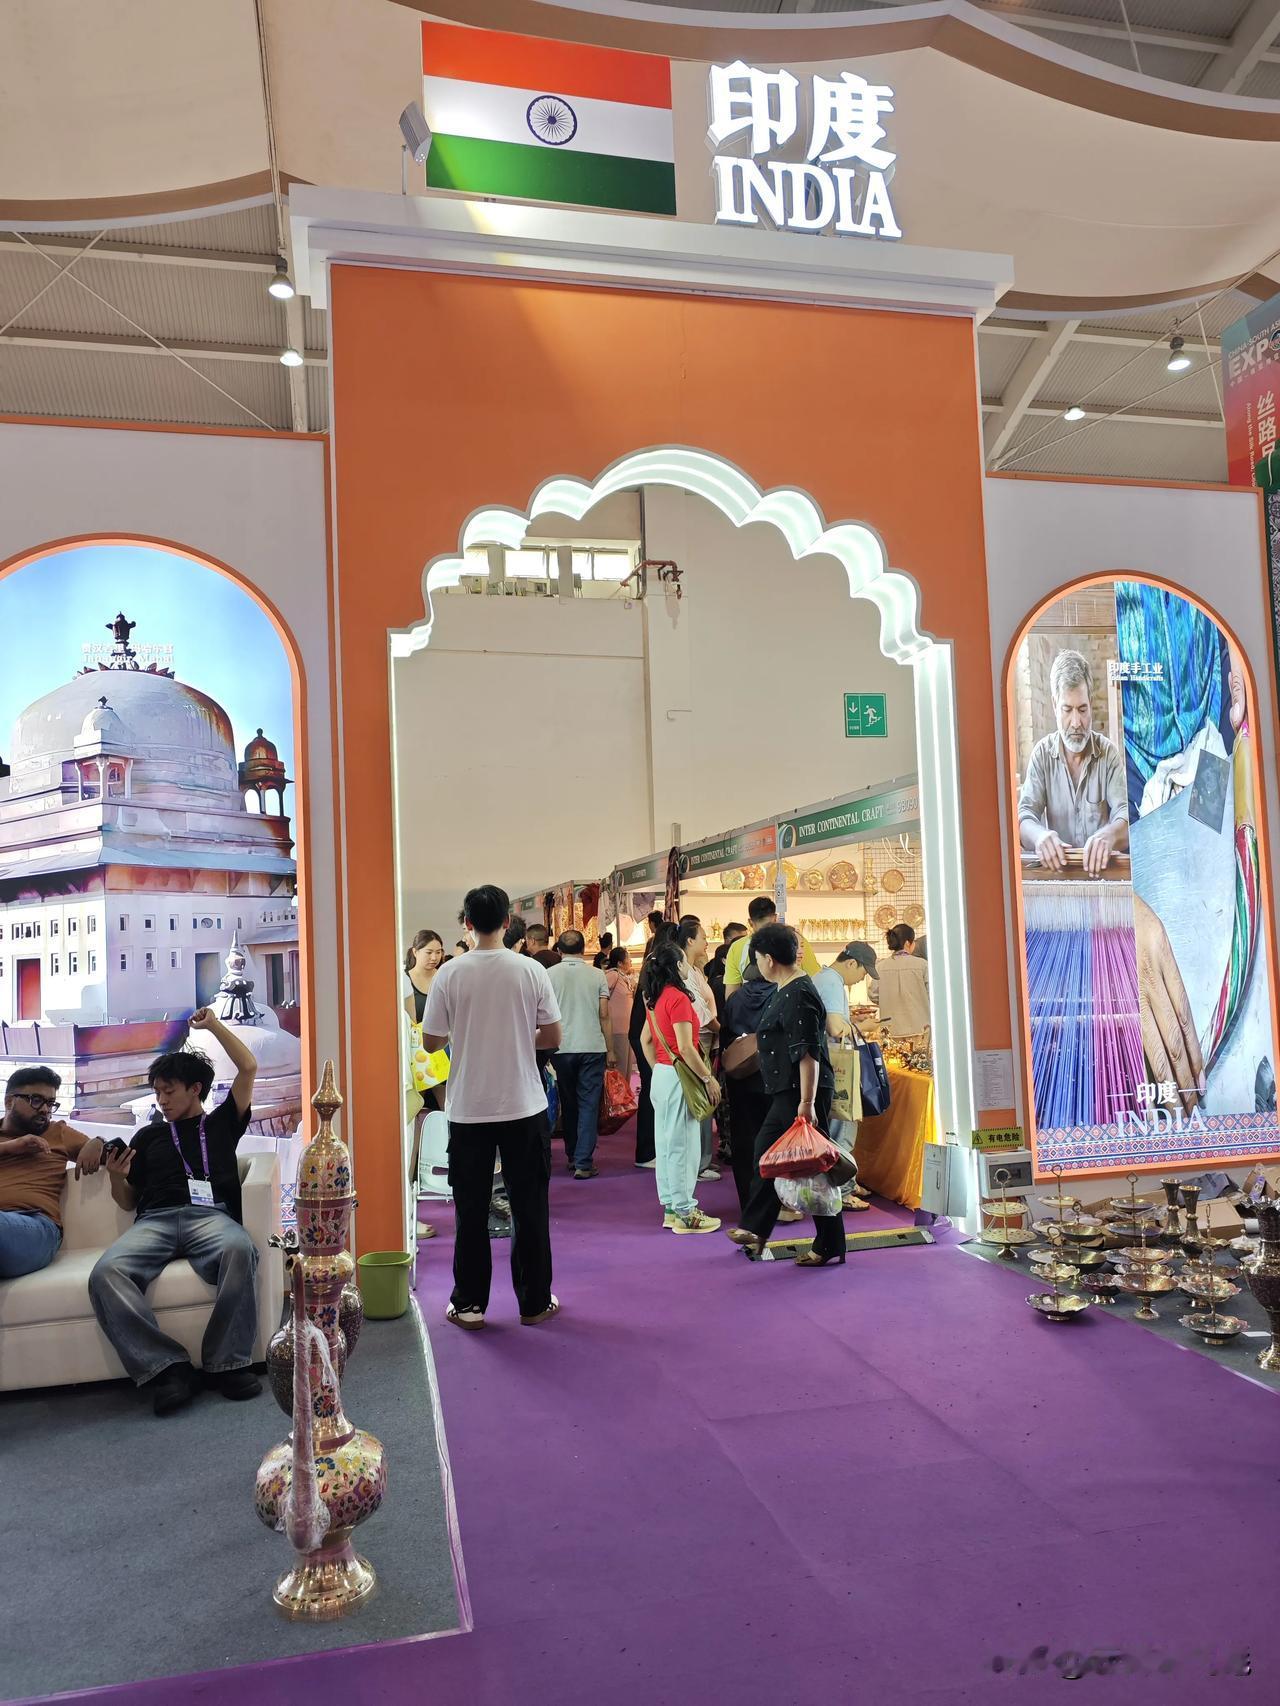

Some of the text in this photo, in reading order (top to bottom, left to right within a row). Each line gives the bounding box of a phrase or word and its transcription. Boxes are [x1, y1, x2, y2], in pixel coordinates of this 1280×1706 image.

[707, 60, 897, 170] 印度
[712, 155, 902, 238] INDIA
[1109, 662, 1164, 674] 印度手工业
[799, 822, 816, 838] INTER
[817, 811, 860, 833] CONTINENTAL
[860, 805, 885, 823] CRAFT
[1136, 1080, 1179, 1105] 印度
[988, 1132, 1020, 1143] 有电危险
[1114, 1104, 1209, 1138] INDIA
